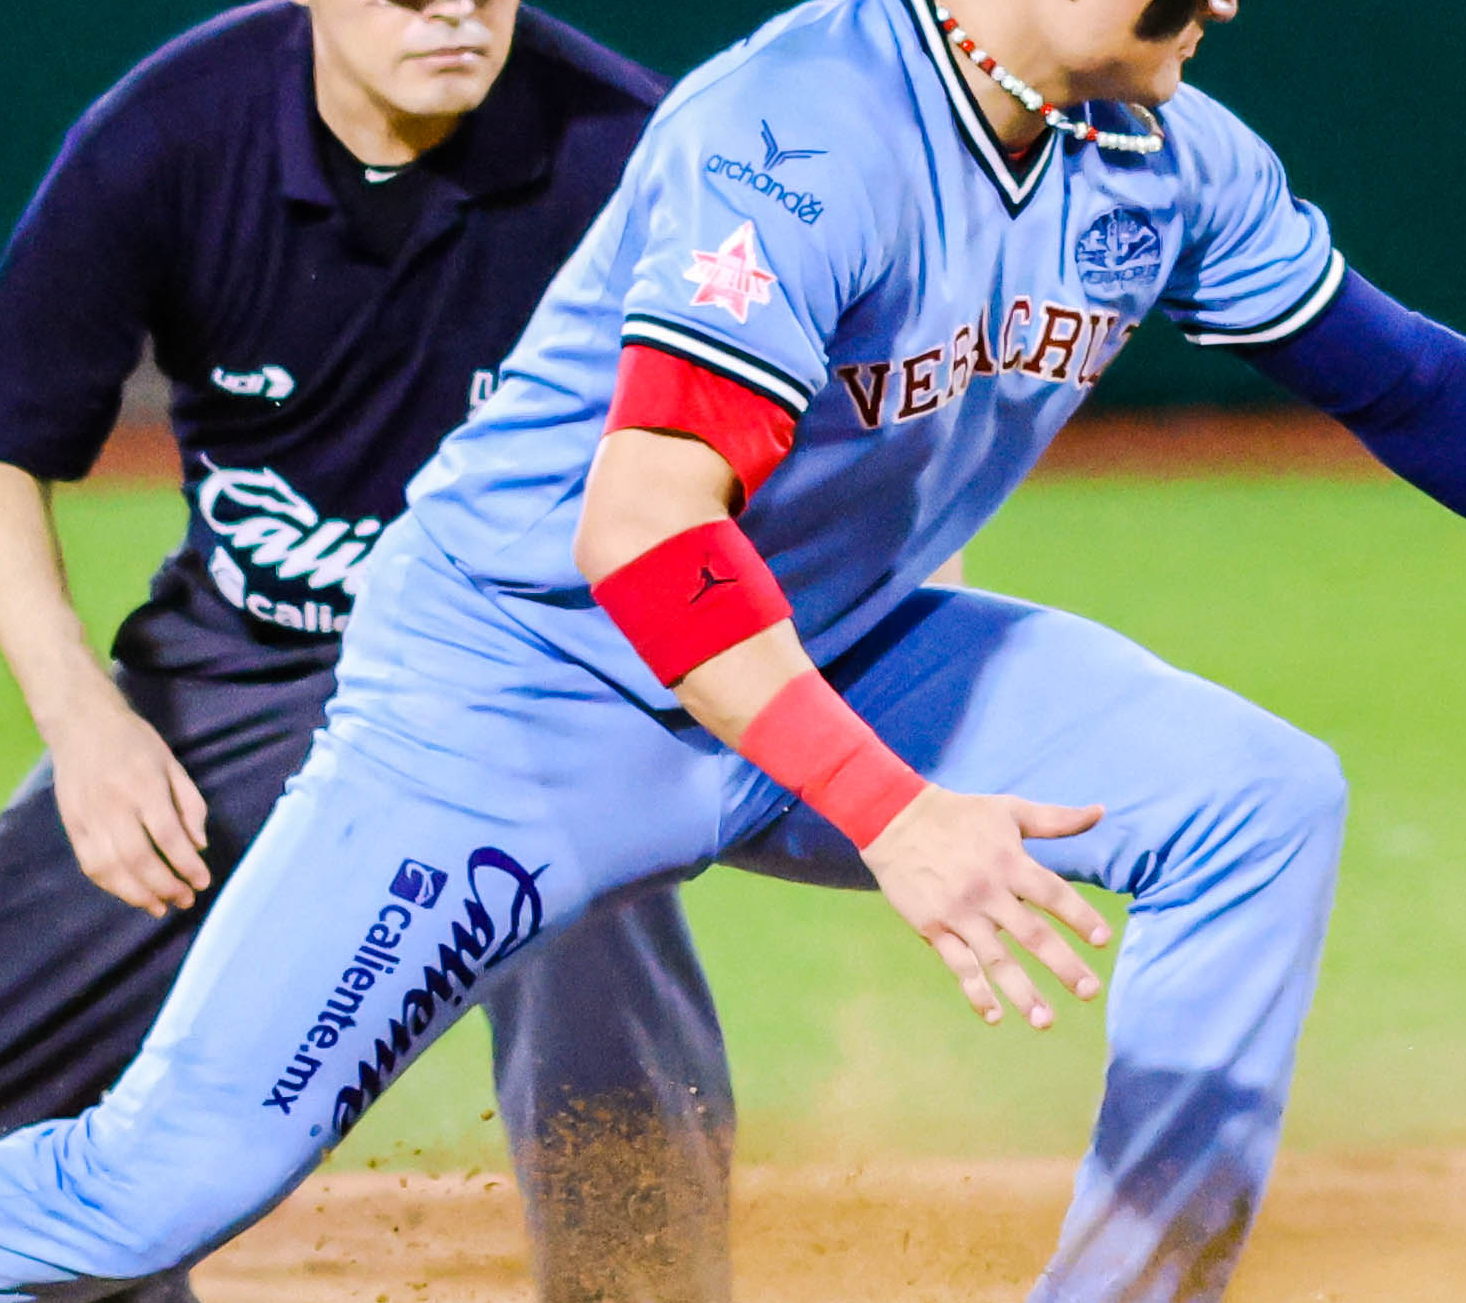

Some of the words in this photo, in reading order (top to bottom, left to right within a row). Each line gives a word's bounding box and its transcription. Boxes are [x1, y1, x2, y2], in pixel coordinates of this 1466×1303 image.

[838, 295, 1141, 430] VERACRU
[196, 449, 382, 596] Cali
[261, 903, 412, 1116] caliente.mx
[332, 845, 551, 1138] Caliente
